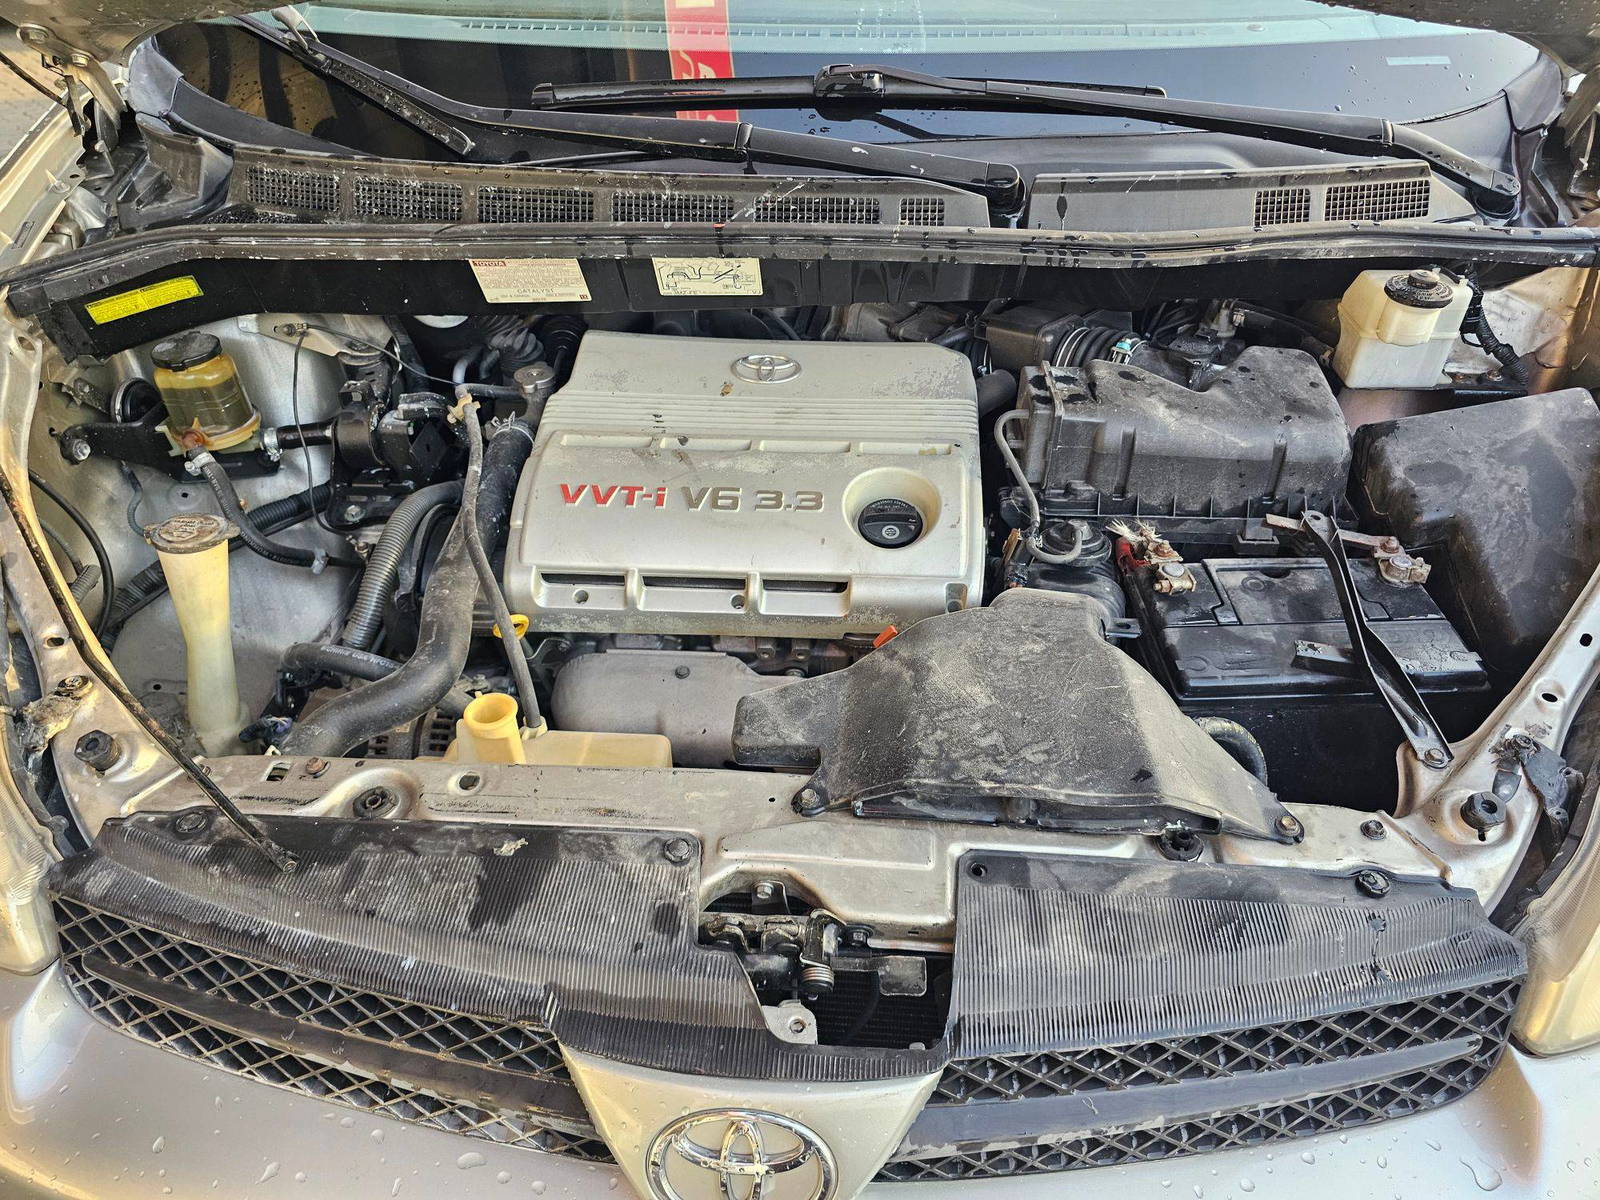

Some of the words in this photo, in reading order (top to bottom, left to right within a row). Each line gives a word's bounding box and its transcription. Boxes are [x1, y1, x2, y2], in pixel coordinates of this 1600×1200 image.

[560, 483, 668, 508] VVT-i
[681, 486, 742, 512] V6
[755, 489, 825, 512] 3.3
